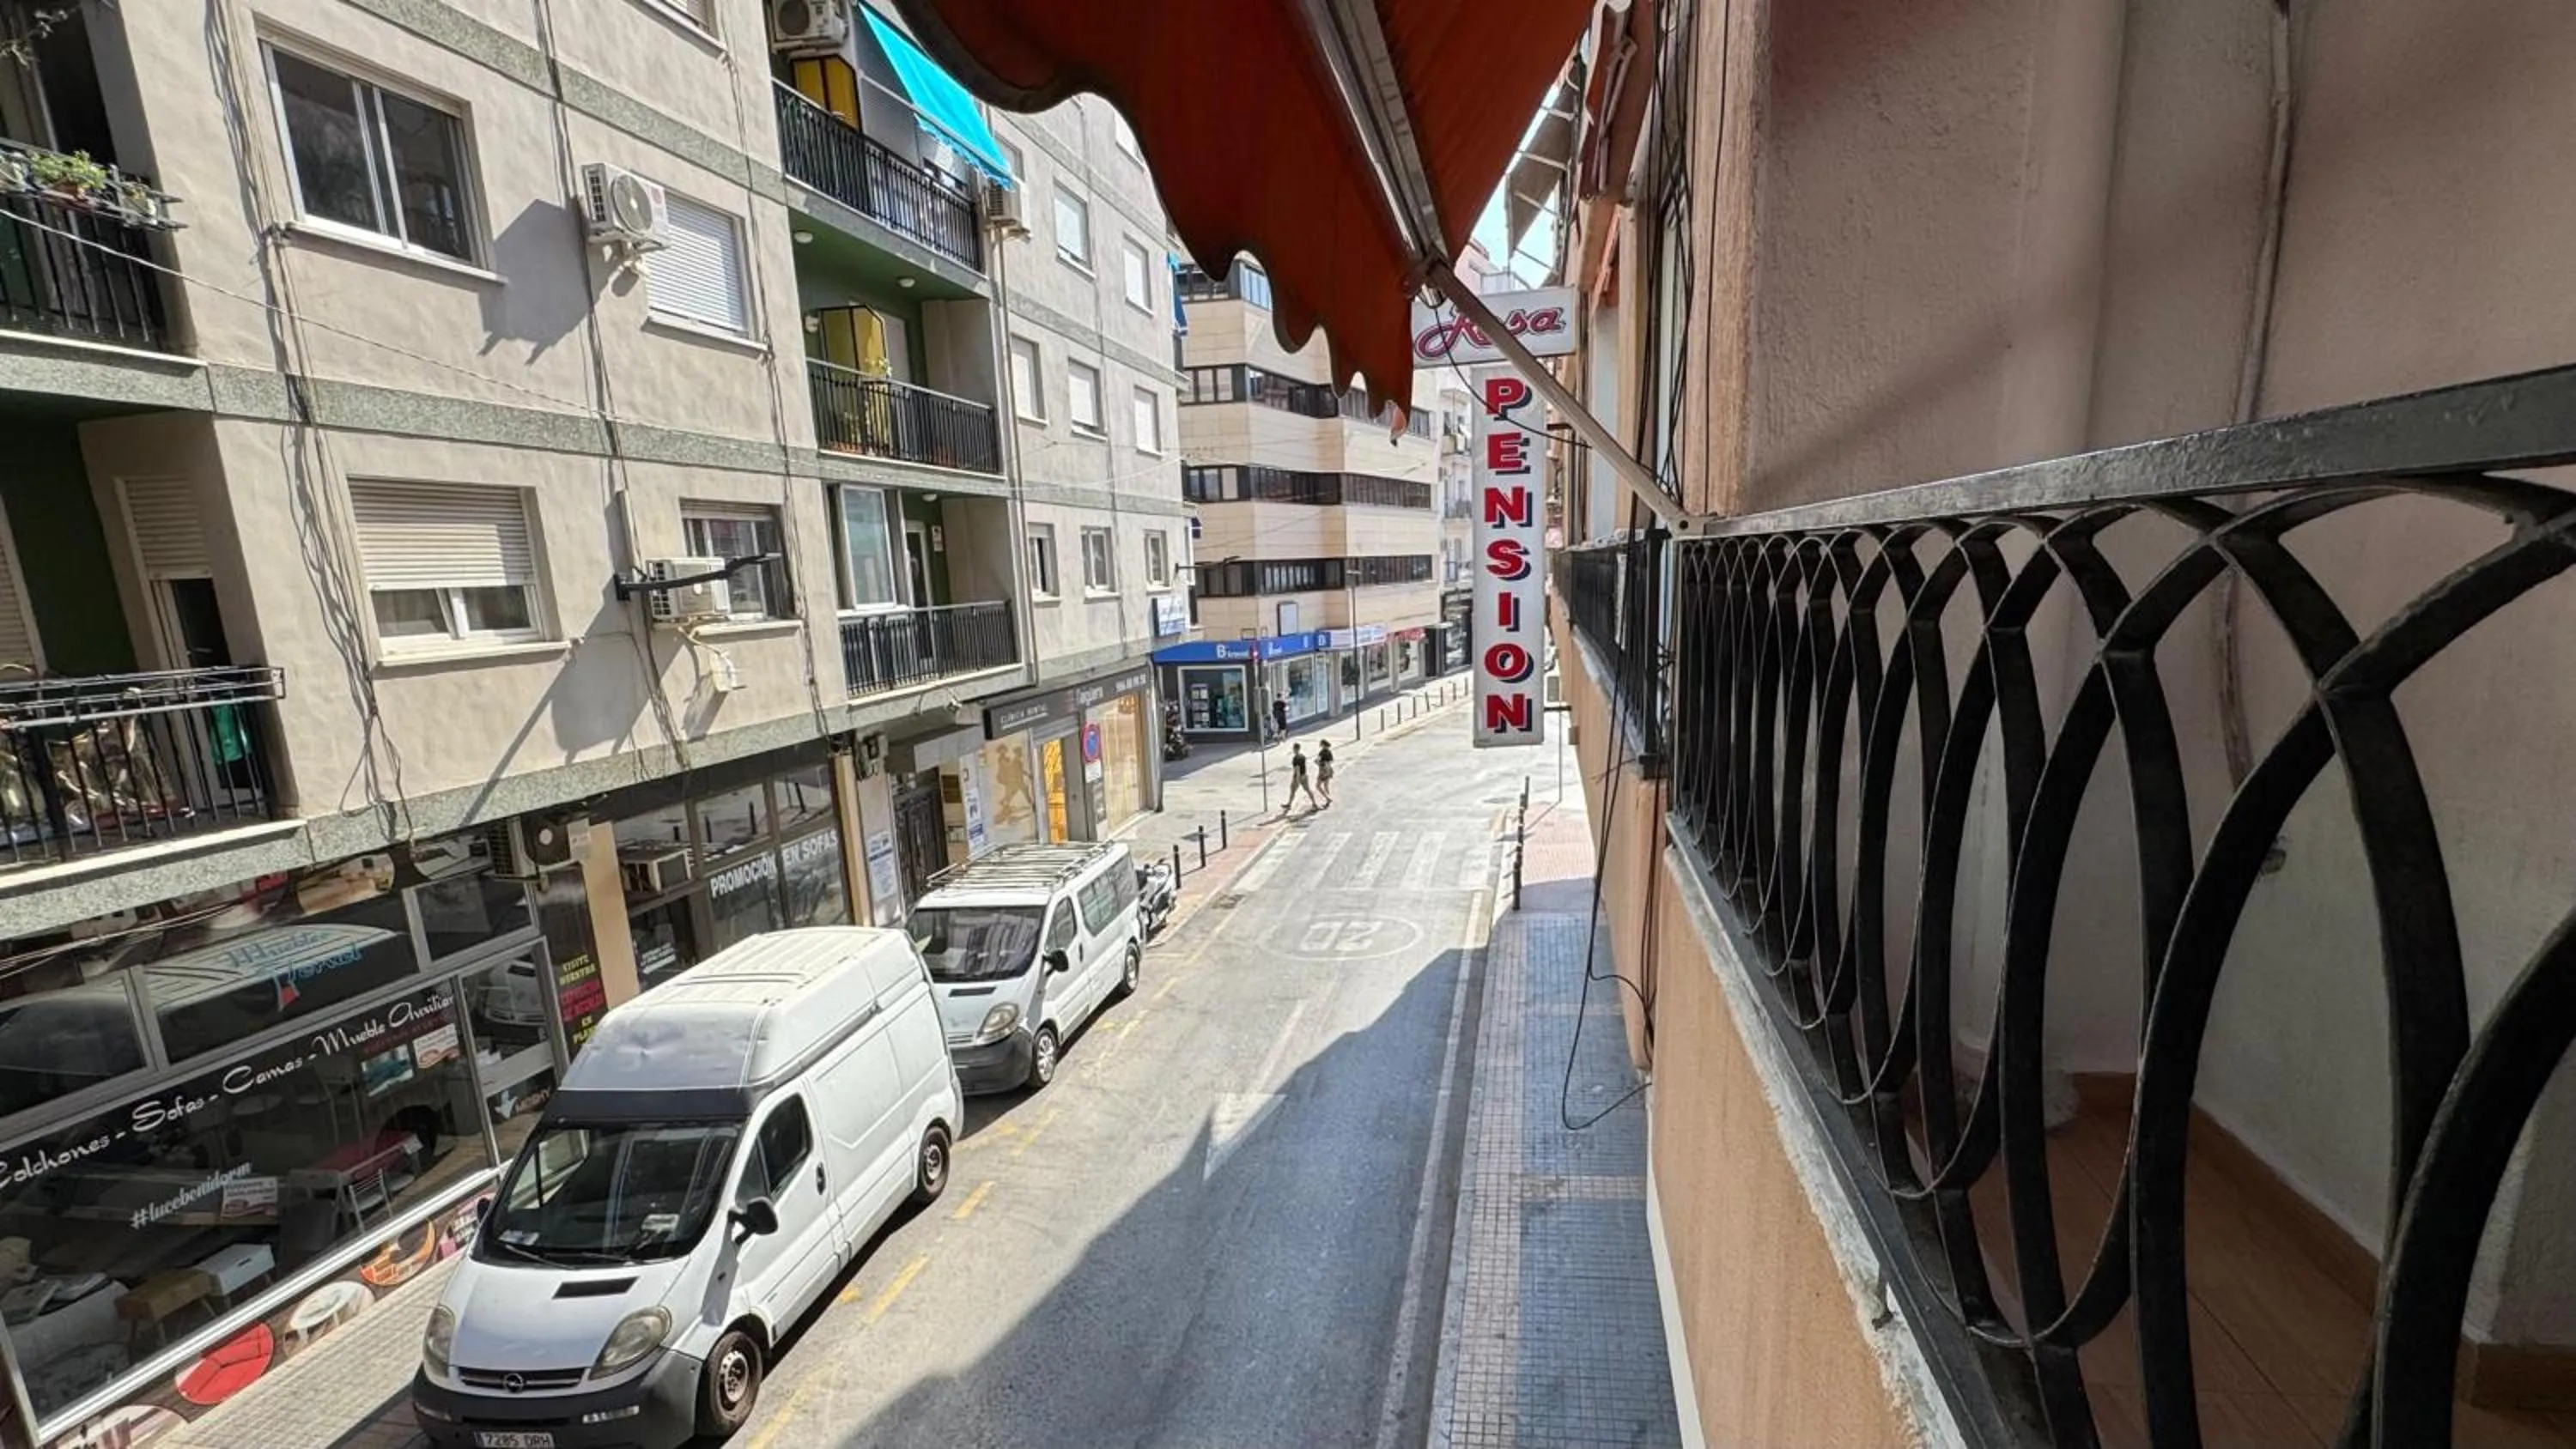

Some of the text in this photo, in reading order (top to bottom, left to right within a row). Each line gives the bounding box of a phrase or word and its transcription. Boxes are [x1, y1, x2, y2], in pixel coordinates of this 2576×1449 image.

[1414, 306, 1567, 361] Rsa
[1483, 377, 1534, 735] PENSION
[131, 1095, 206, 1132] Sofas
[222, 1064, 303, 1094] Camas
[311, 1019, 386, 1056] Mueble
